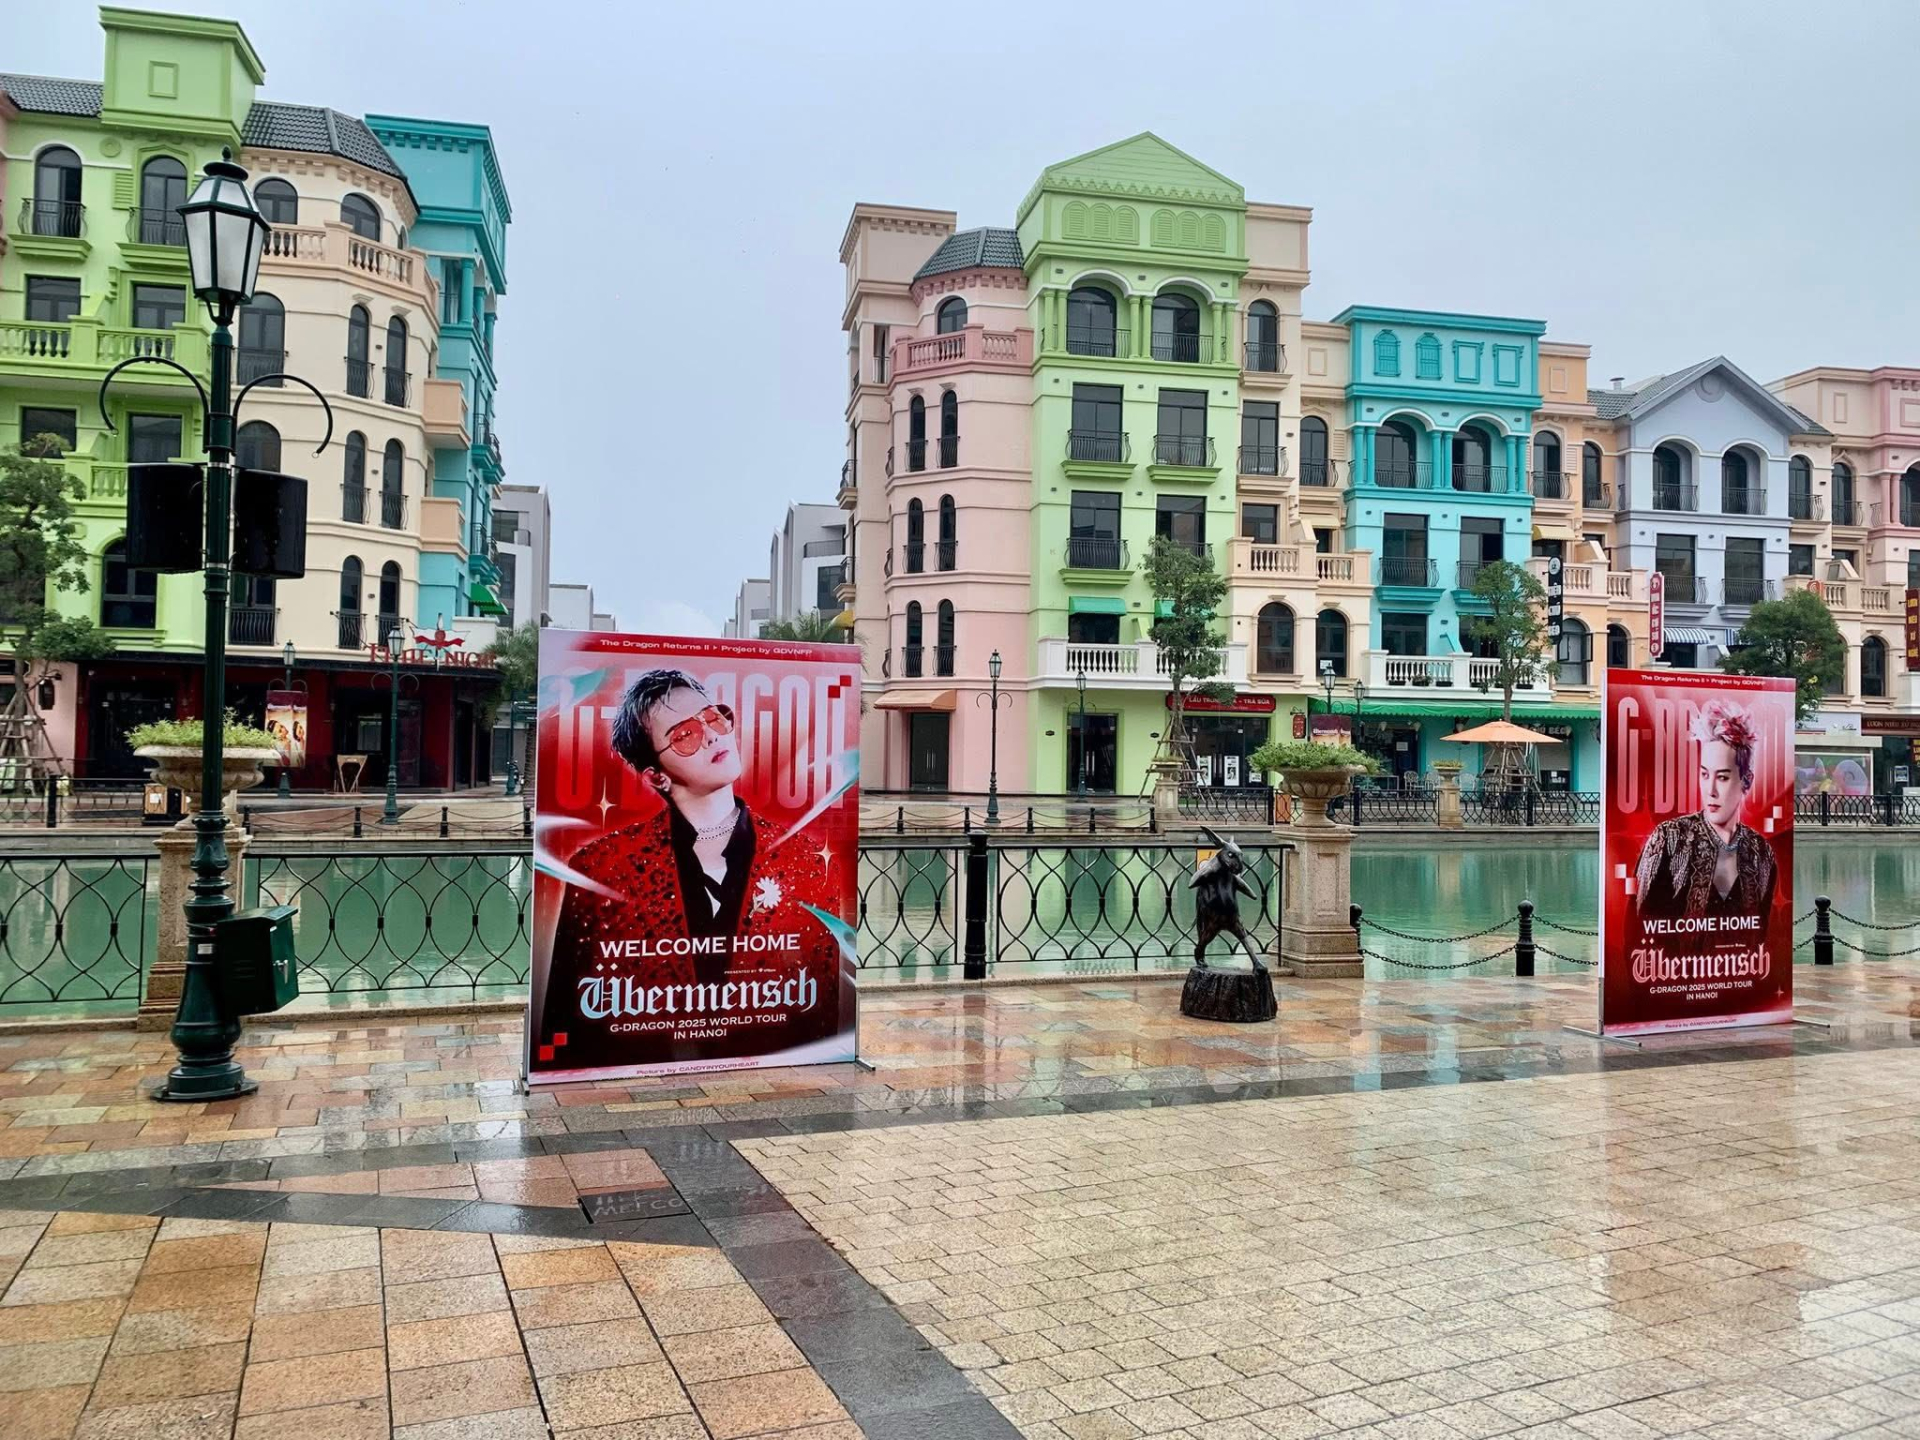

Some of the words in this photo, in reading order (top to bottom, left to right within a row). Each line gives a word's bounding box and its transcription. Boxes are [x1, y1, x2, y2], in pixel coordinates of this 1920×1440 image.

[600, 639, 619, 647] The
[623, 640, 660, 649] Dragon
[663, 642, 701, 651] Returns
[721, 645, 756, 653] Project
[759, 647, 771, 655] by
[1711, 678, 1732, 686] Project
[1643, 917, 1717, 934] WELCOME
[1720, 916, 1760, 931] HOME
[600, 936, 727, 958] WELCOME
[733, 933, 800, 953] HOME
[1631, 937, 1770, 984] Übermensch
[577, 962, 818, 1020] Übermensch
[1650, 984, 1688, 994] G-DRAGON
[1689, 983, 1706, 992] 2025
[1706, 981, 1733, 990] WORLD
[1733, 980, 1753, 988] TOUR
[1695, 992, 1718, 1000] HANOI
[610, 1020, 675, 1033] G-DRAGON
[677, 1018, 707, 1029] 2025
[709, 1015, 753, 1027] WORLD
[755, 1013, 787, 1023] TOUR
[673, 1031, 686, 1040] IN
[689, 1028, 727, 1039] HANOI
